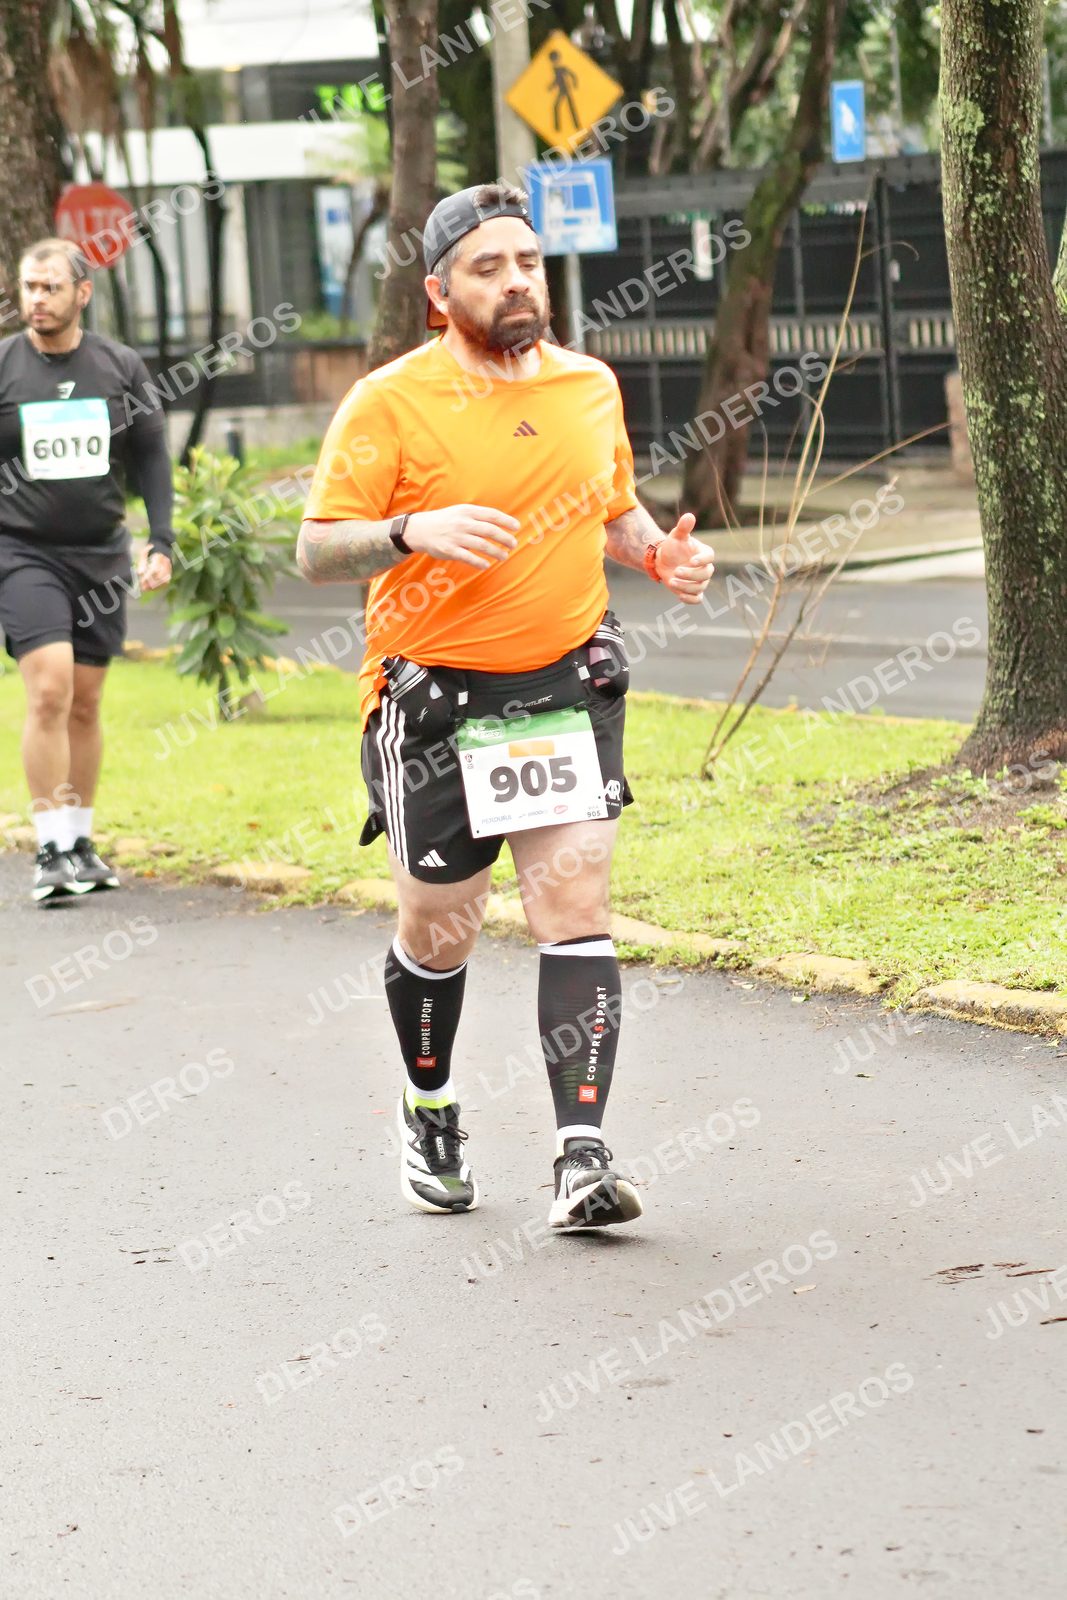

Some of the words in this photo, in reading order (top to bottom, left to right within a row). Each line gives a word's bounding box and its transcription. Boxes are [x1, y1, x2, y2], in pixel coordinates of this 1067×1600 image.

[33, 435, 103, 460] 6010
[489, 756, 578, 804] 905
[586, 811, 602, 819] 905
[421, 997, 435, 1056] COMPRESSPORT
[586, 985, 607, 1081] COMPRESSPORT
